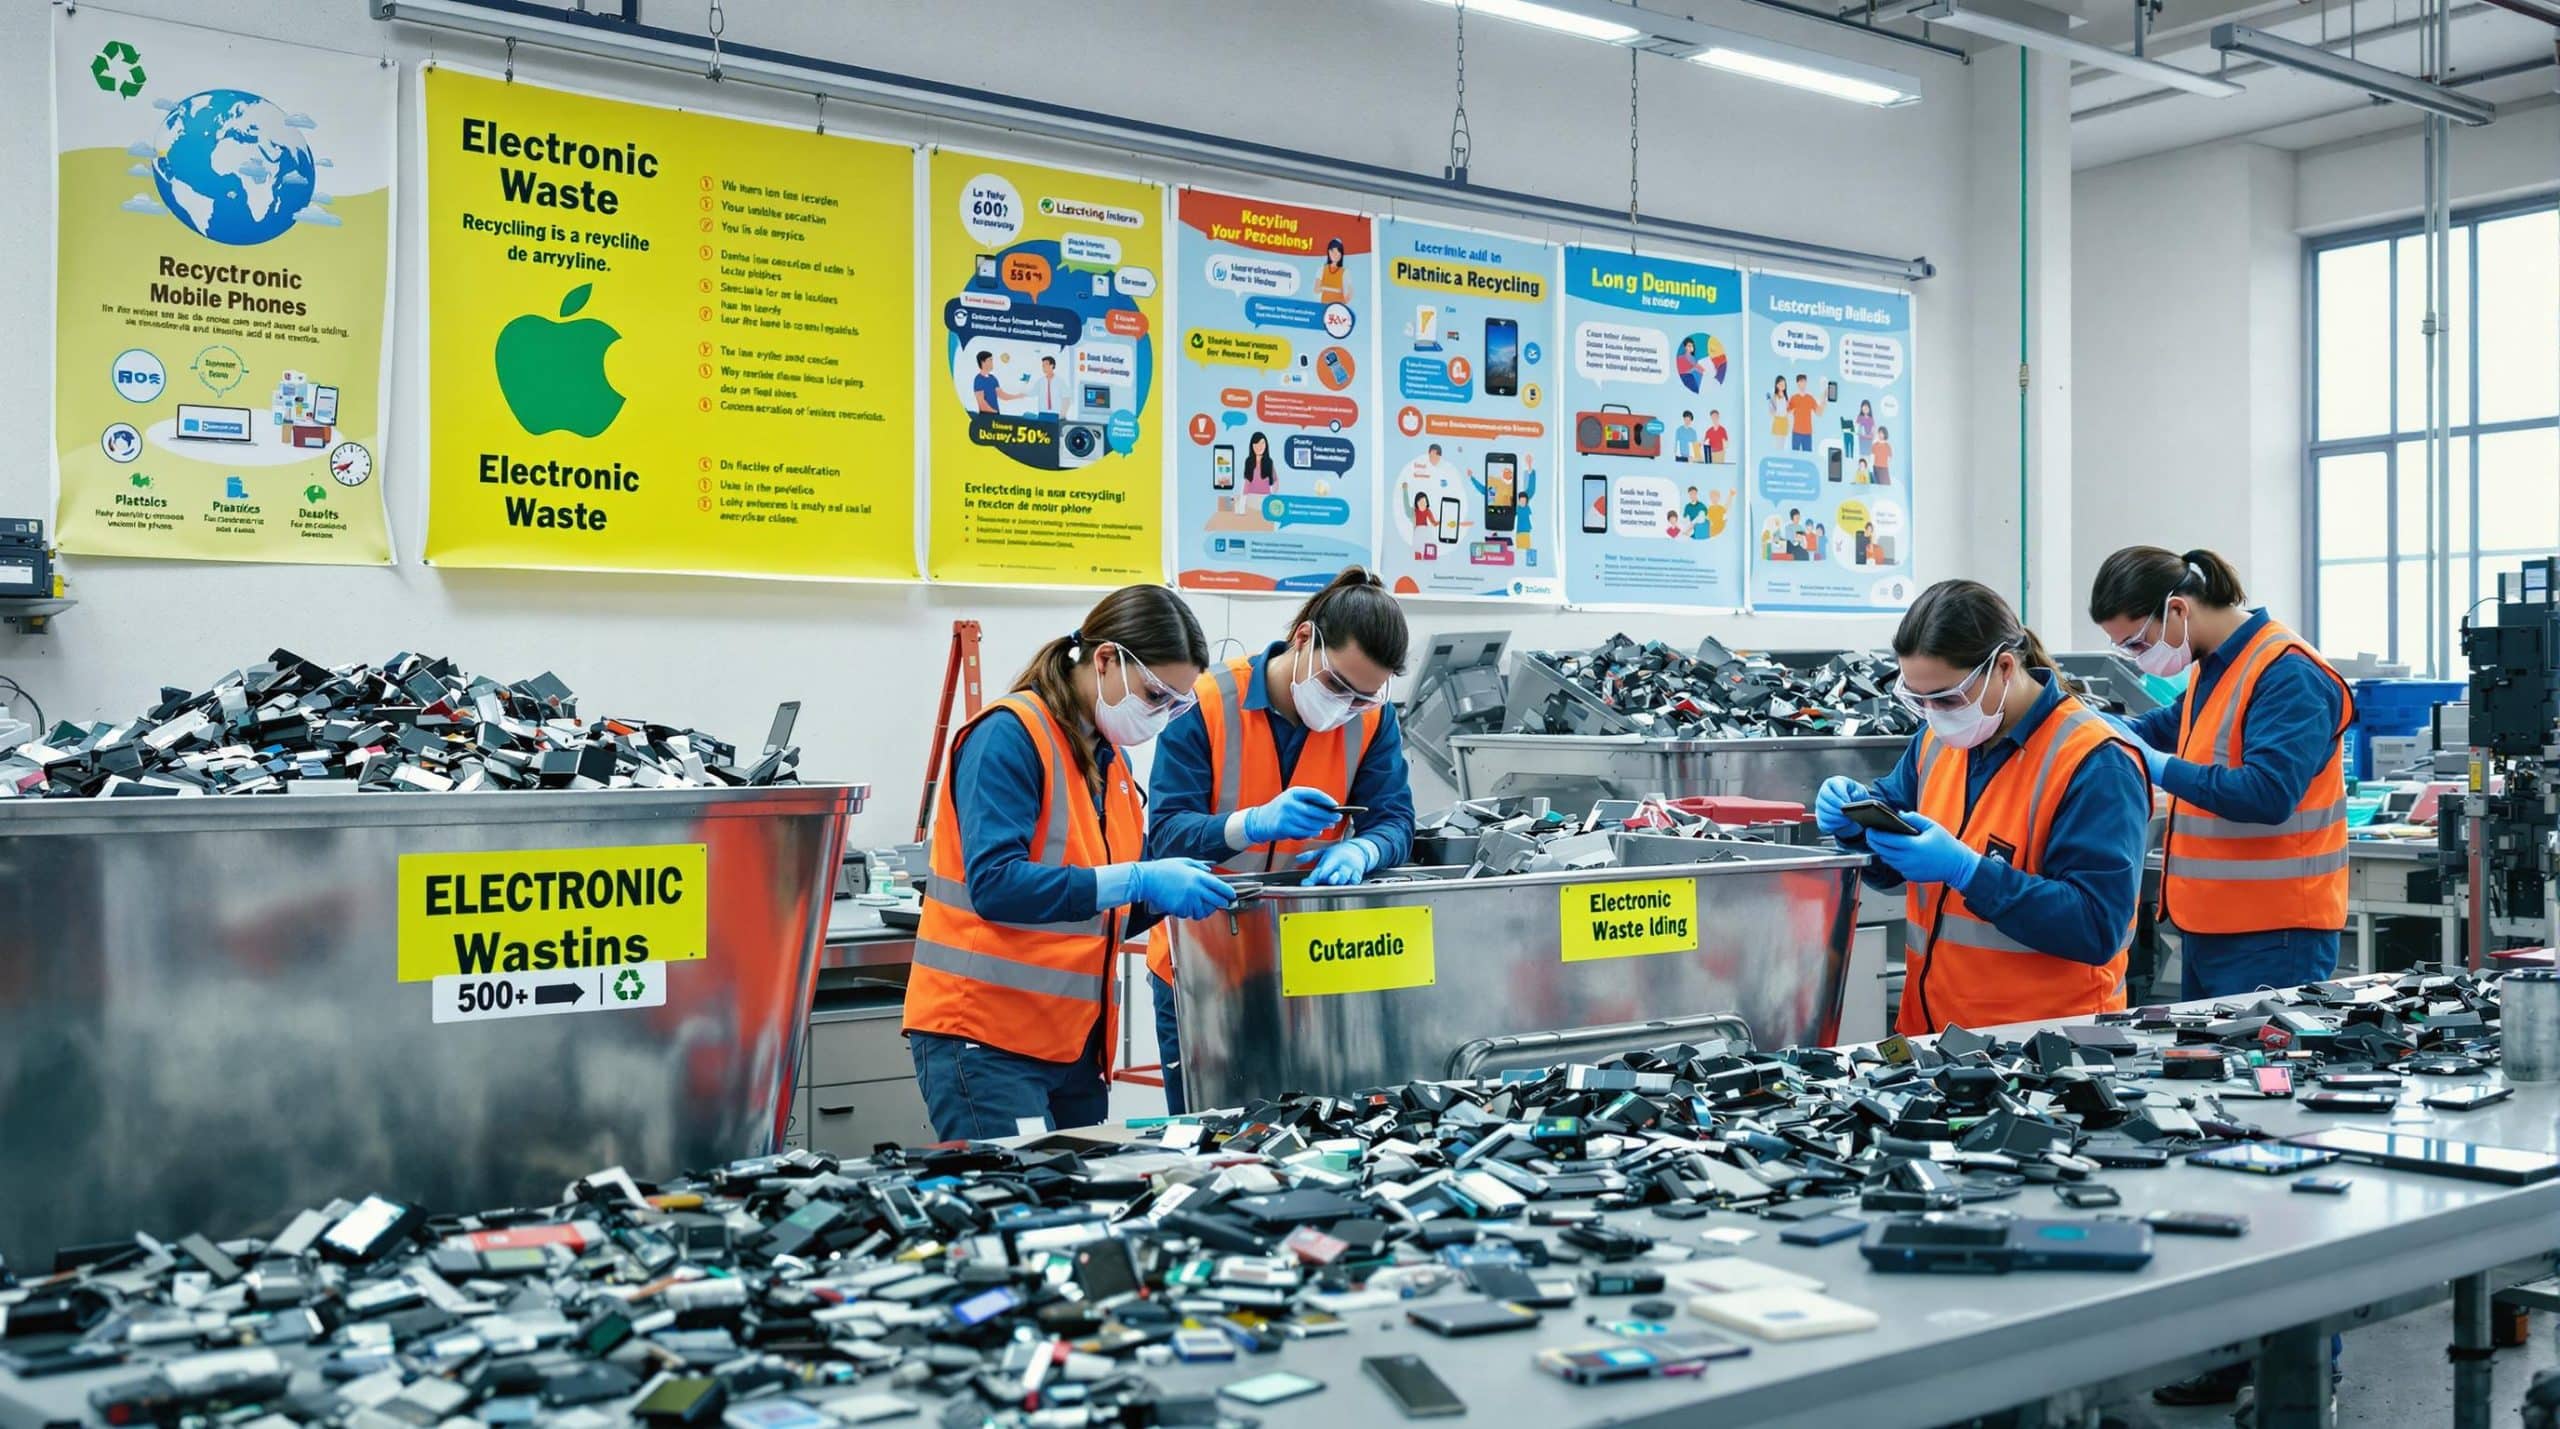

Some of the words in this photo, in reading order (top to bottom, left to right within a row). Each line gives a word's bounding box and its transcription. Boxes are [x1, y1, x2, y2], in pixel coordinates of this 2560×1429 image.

[462, 117, 659, 179] Electronic
[500, 167, 618, 215] Waste
[551, 224, 565, 241] is
[570, 231, 580, 243] a
[1211, 223, 1242, 240] Your
[507, 246, 527, 261] de
[159, 255, 302, 290] Recyctronic
[1454, 274, 1463, 286] a
[1467, 271, 1540, 297] Recycling
[150, 283, 222, 308] Mobile
[228, 291, 307, 316] Phones
[480, 454, 639, 492] Electronic
[505, 496, 607, 531] Waste
[426, 866, 683, 917] ELECTRONIC
[1590, 889, 1672, 913] Electronic
[1592, 920, 1644, 941] Waste
[453, 926, 649, 975] Wastins
[457, 980, 528, 1013] 500+
